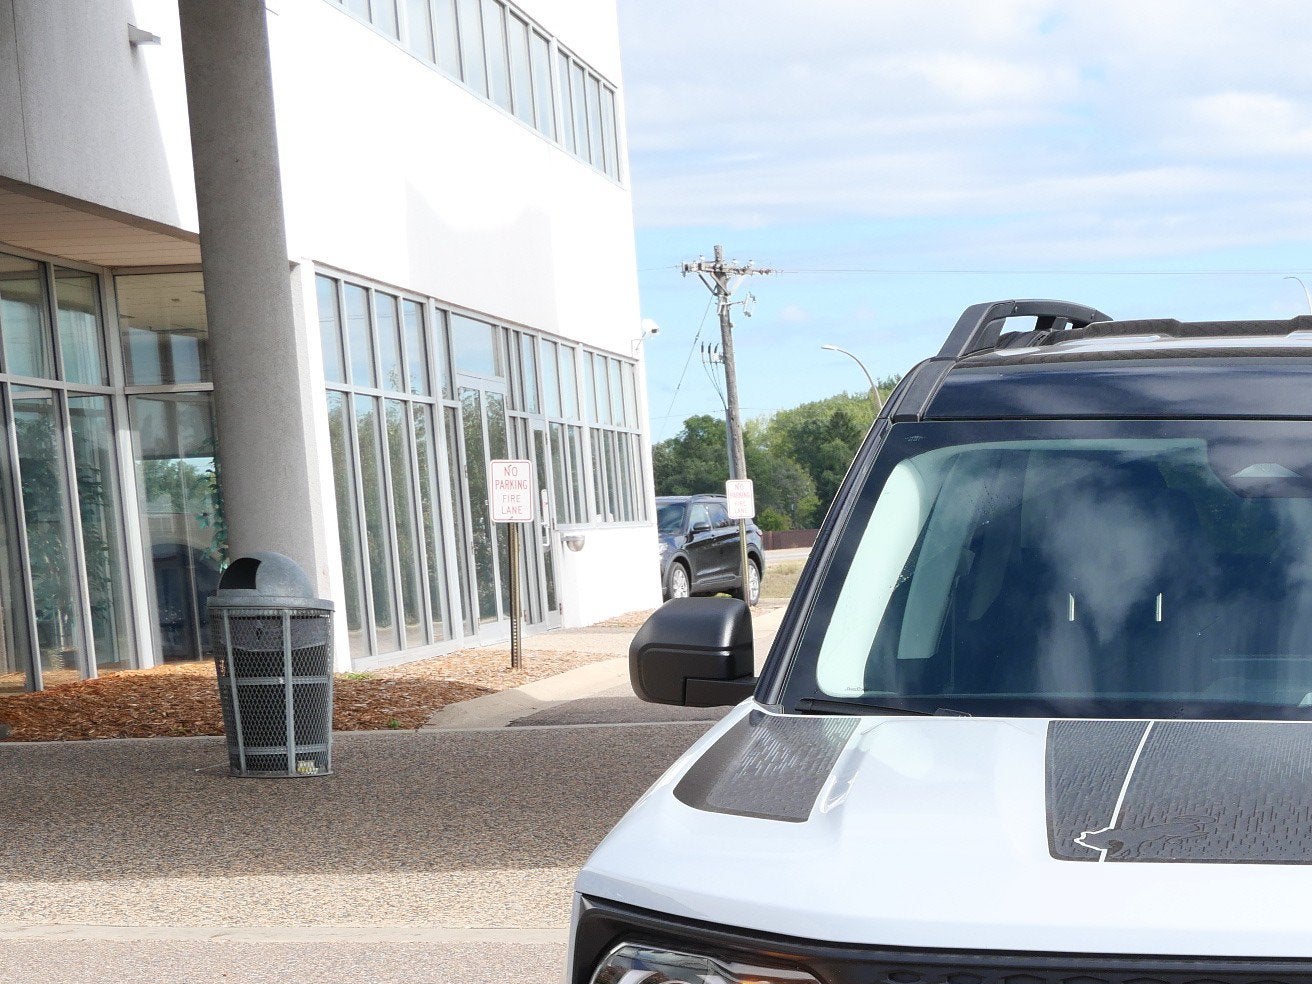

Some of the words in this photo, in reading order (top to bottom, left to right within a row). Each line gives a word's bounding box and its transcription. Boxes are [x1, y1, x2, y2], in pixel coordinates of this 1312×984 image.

[504, 466, 518, 477] NO
[495, 479, 528, 490] PARKING
[502, 494, 521, 503] FIRE
[501, 505, 523, 515] LANE
